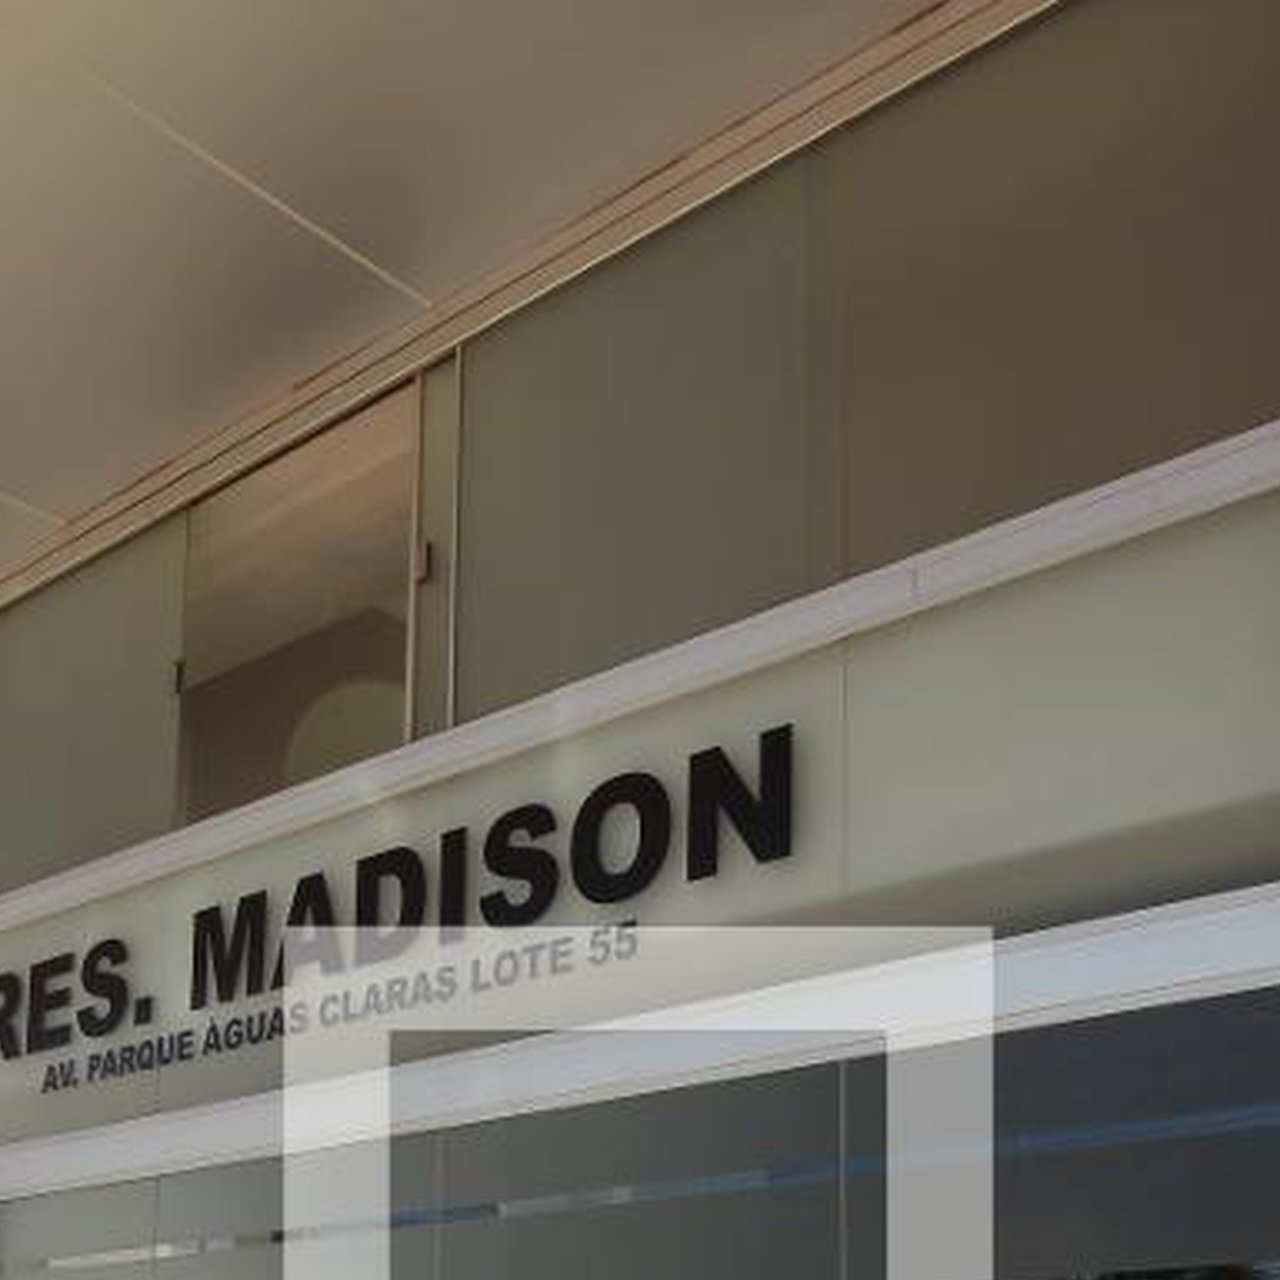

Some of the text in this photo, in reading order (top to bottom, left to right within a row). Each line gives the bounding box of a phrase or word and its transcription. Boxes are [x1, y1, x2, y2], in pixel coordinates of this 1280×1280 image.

[190, 722, 795, 1011] MADISON
[41, 1057, 79, 1094] AV.
[85, 1030, 195, 1083] PARQUE
[319, 966, 459, 1028] CLARAS
[471, 937, 575, 994] LOTE
[586, 919, 639, 966] 55
